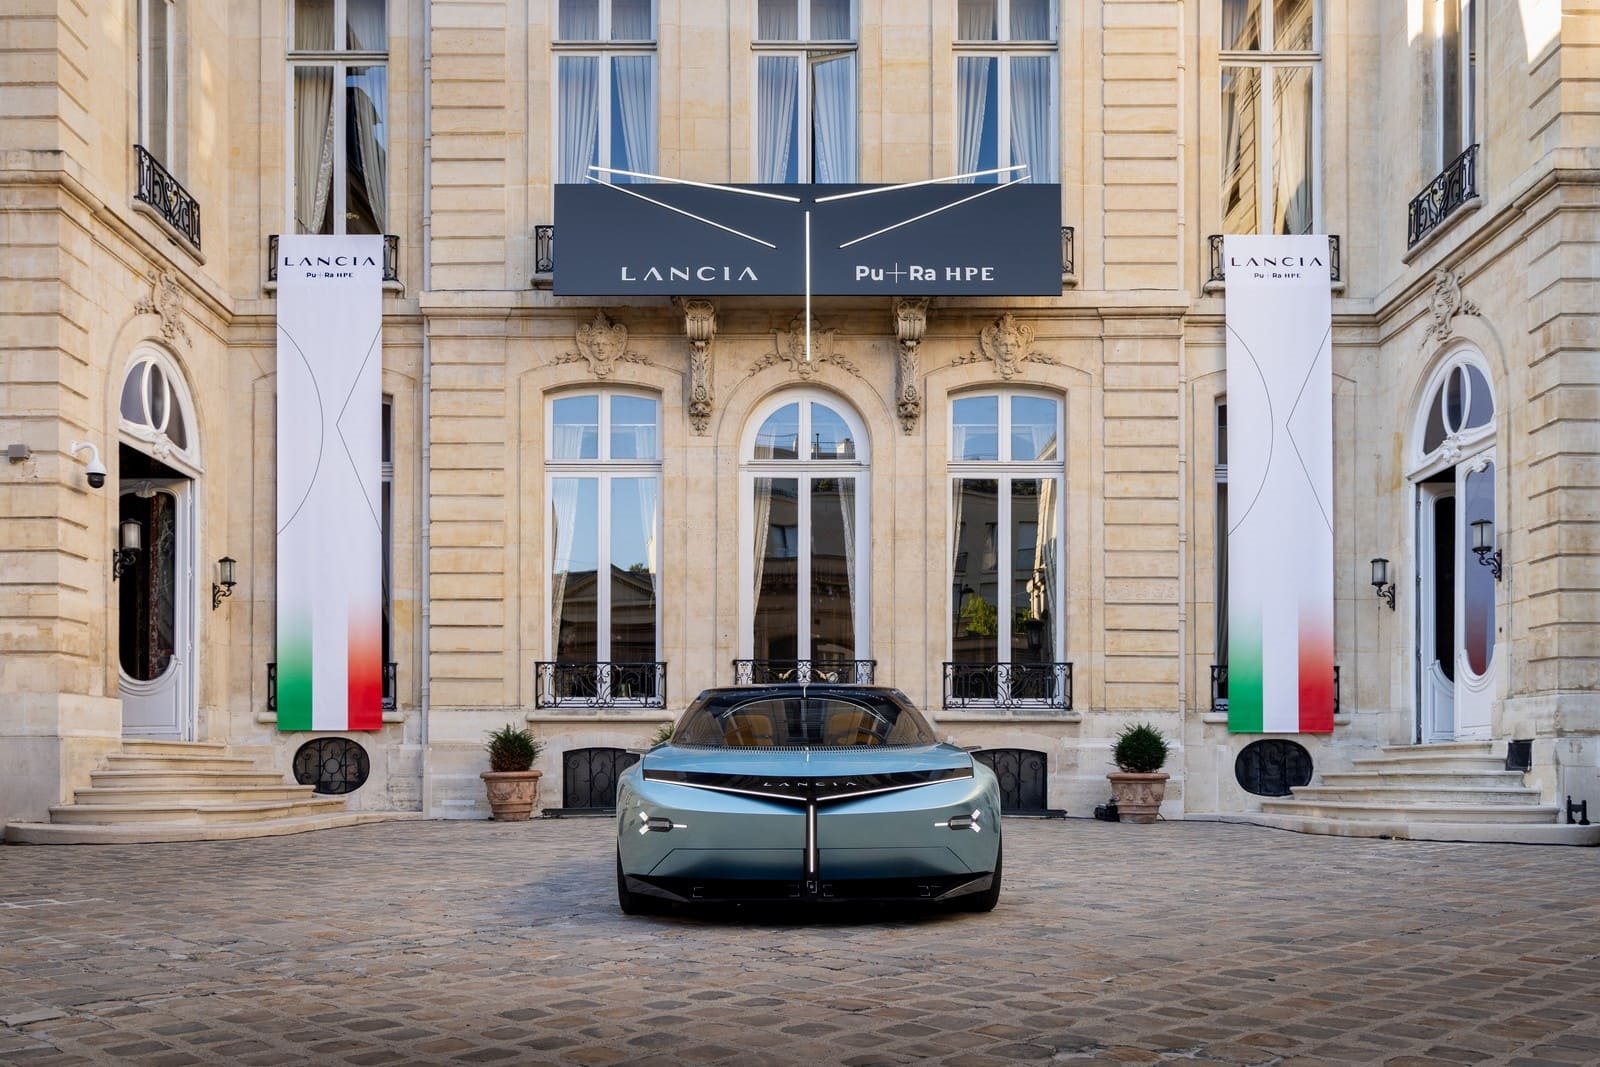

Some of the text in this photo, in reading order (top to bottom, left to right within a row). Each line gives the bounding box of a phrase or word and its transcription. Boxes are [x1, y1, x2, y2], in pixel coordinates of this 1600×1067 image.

[284, 256, 376, 266] LANCIA
[1231, 256, 1323, 267] LANCIA
[620, 266, 759, 282] LANCIA
[945, 266, 995, 281] HPE
